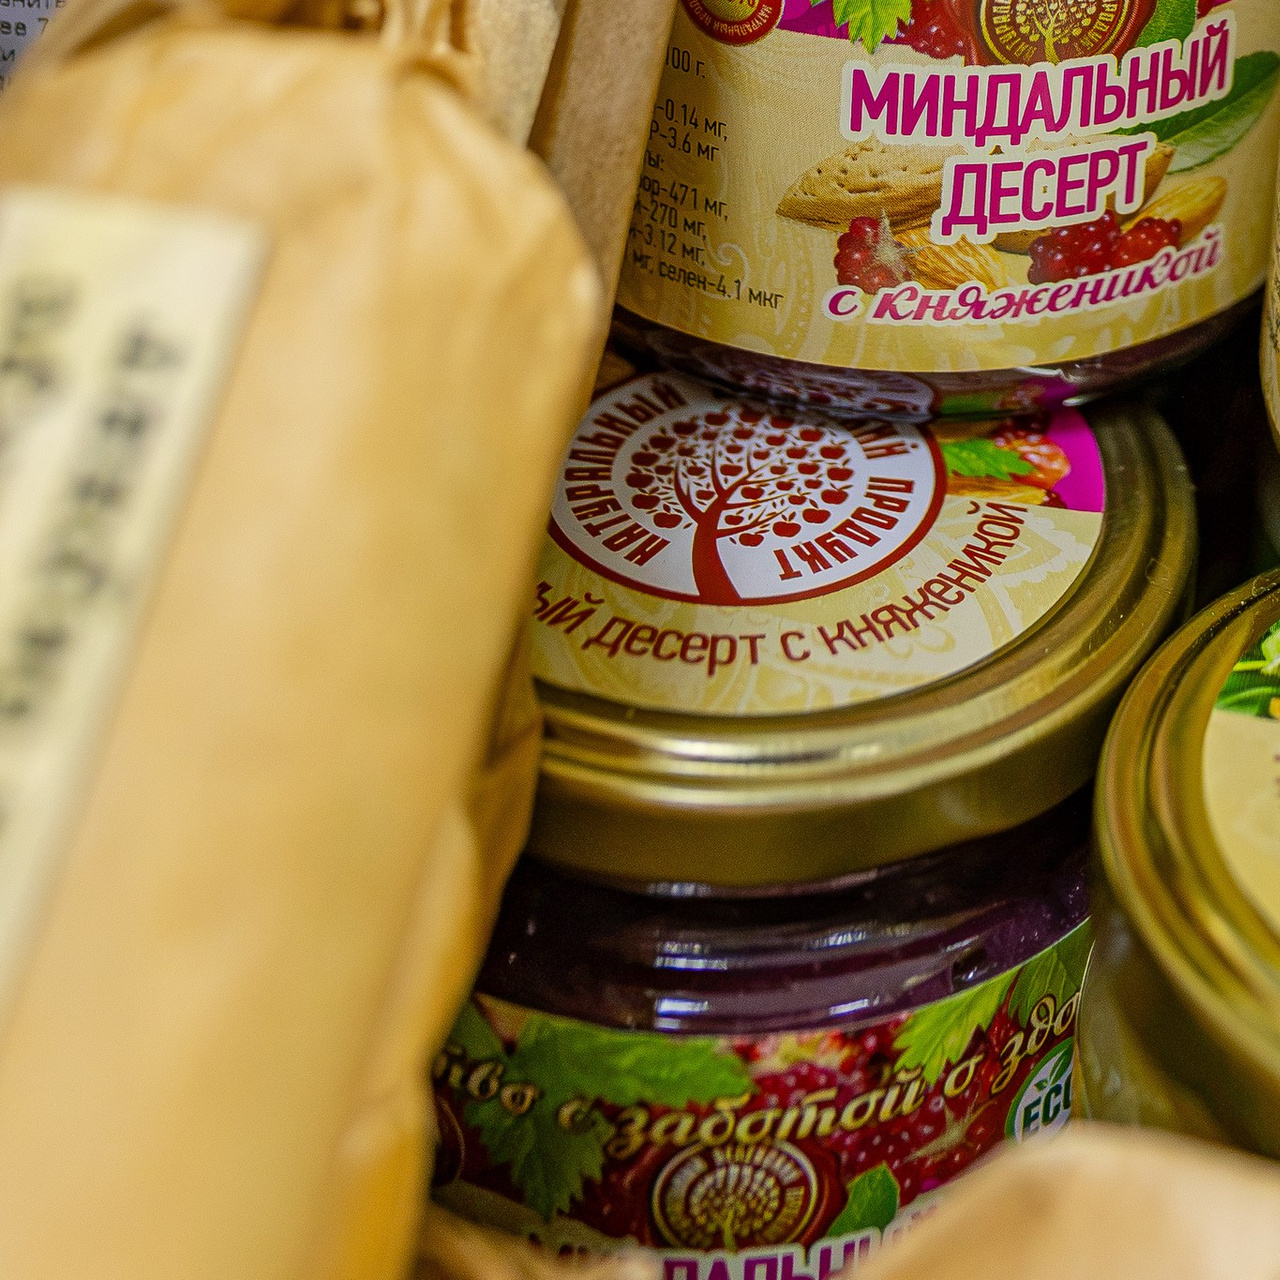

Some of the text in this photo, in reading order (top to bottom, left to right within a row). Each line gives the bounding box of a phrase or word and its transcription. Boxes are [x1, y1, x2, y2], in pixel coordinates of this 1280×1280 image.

[848, 17, 1228, 148] МИНДАЛЬНЫЙ
[697, 141, 720, 162] мг
[940, 142, 1149, 236] ДЕСЕРТ
[658, 260, 742, 301] селен-4.1
[748, 287, 785, 310] мкг
[828, 288, 861, 317] с
[875, 237, 1225, 323] княженикой
[773, 476, 916, 581] ПРОДУКТ
[581, 500, 1028, 678] десерт с княженикой
[607, 1066, 929, 1160] заботой
